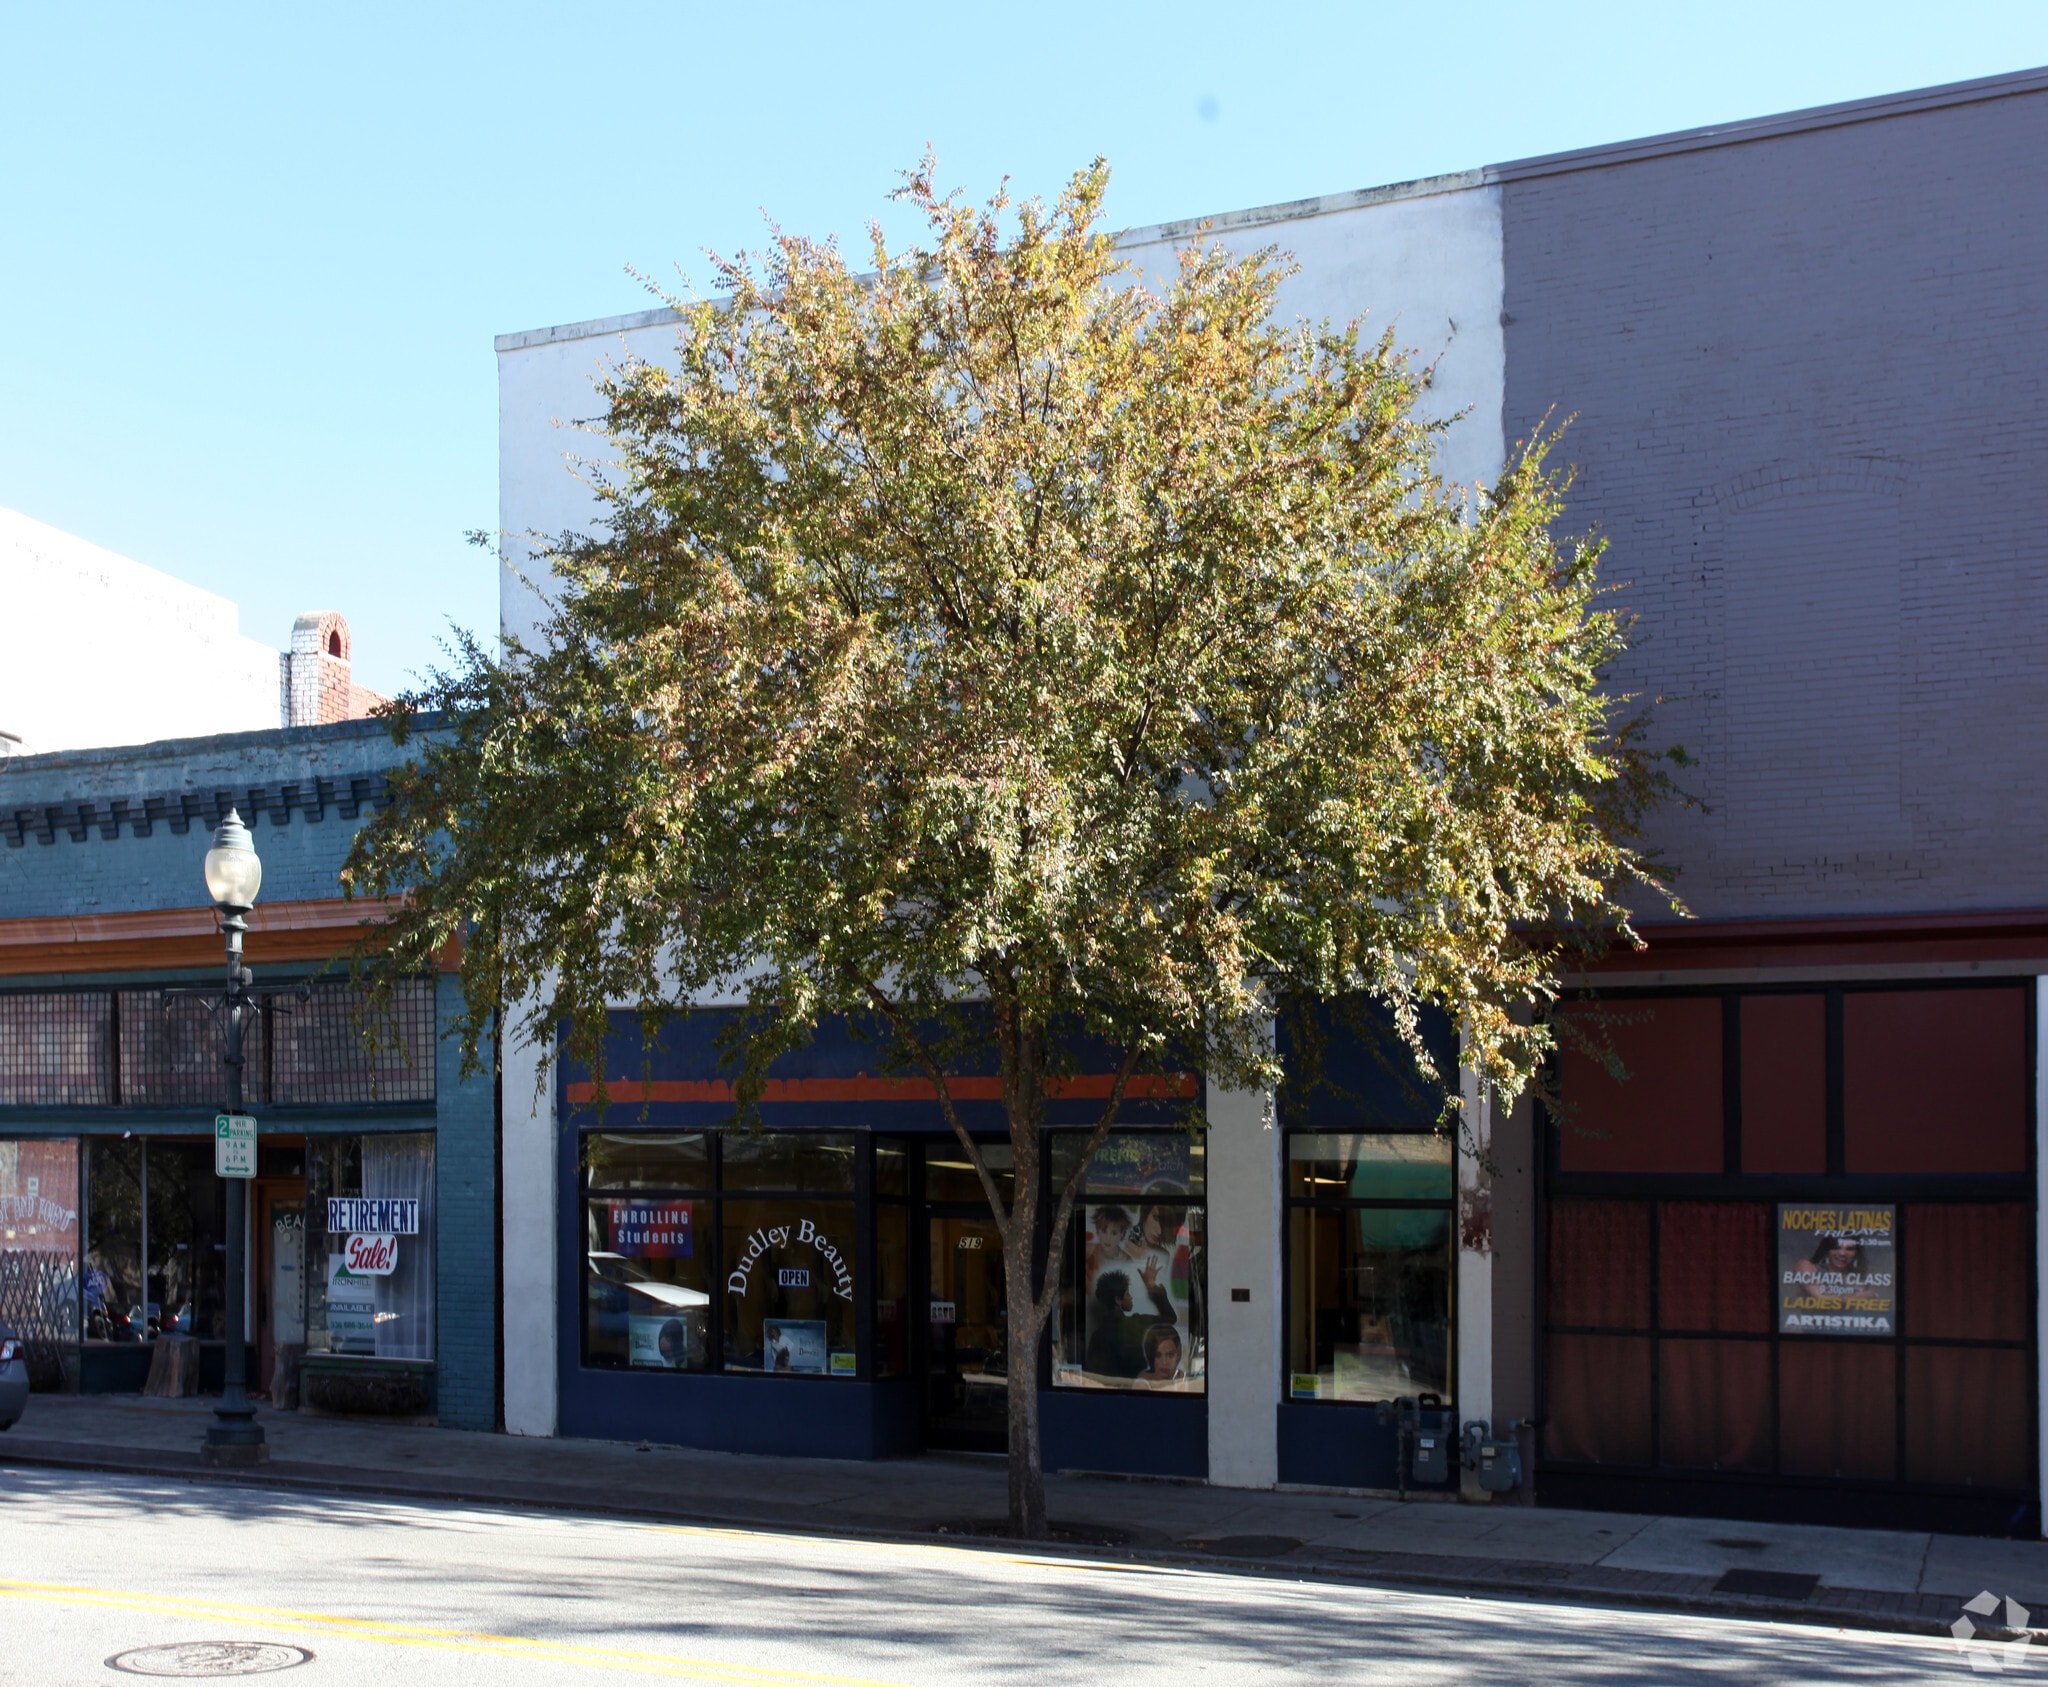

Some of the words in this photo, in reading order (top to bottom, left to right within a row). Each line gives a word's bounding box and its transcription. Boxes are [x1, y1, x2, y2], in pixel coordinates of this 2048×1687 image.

[219, 1120, 228, 1135] 2
[229, 1128, 254, 1138] PARKING
[329, 1200, 416, 1232] RETIREMENT
[613, 1209, 689, 1225] ENROLLING
[1782, 1210, 1837, 1230] NOCHES
[1838, 1211, 1892, 1231] LATINAS
[618, 1228, 684, 1244] Students
[1814, 1228, 1889, 1237] FRIDAYS
[960, 1238, 982, 1248] 519
[348, 1237, 395, 1270] Sale!
[728, 1225, 791, 1297] Dudley
[797, 1218, 853, 1302] Beauty
[781, 1271, 808, 1285] OPEN
[1783, 1271, 1844, 1285] BACHATA
[1846, 1273, 1892, 1287] CLASS
[1820, 1285, 1855, 1296] 9:30pm
[330, 1303, 372, 1313] AVAILABLE
[1783, 1297, 1843, 1311] LADIES
[1845, 1299, 1891, 1311] FREE
[1785, 1314, 1891, 1328] ARTISTIKA
